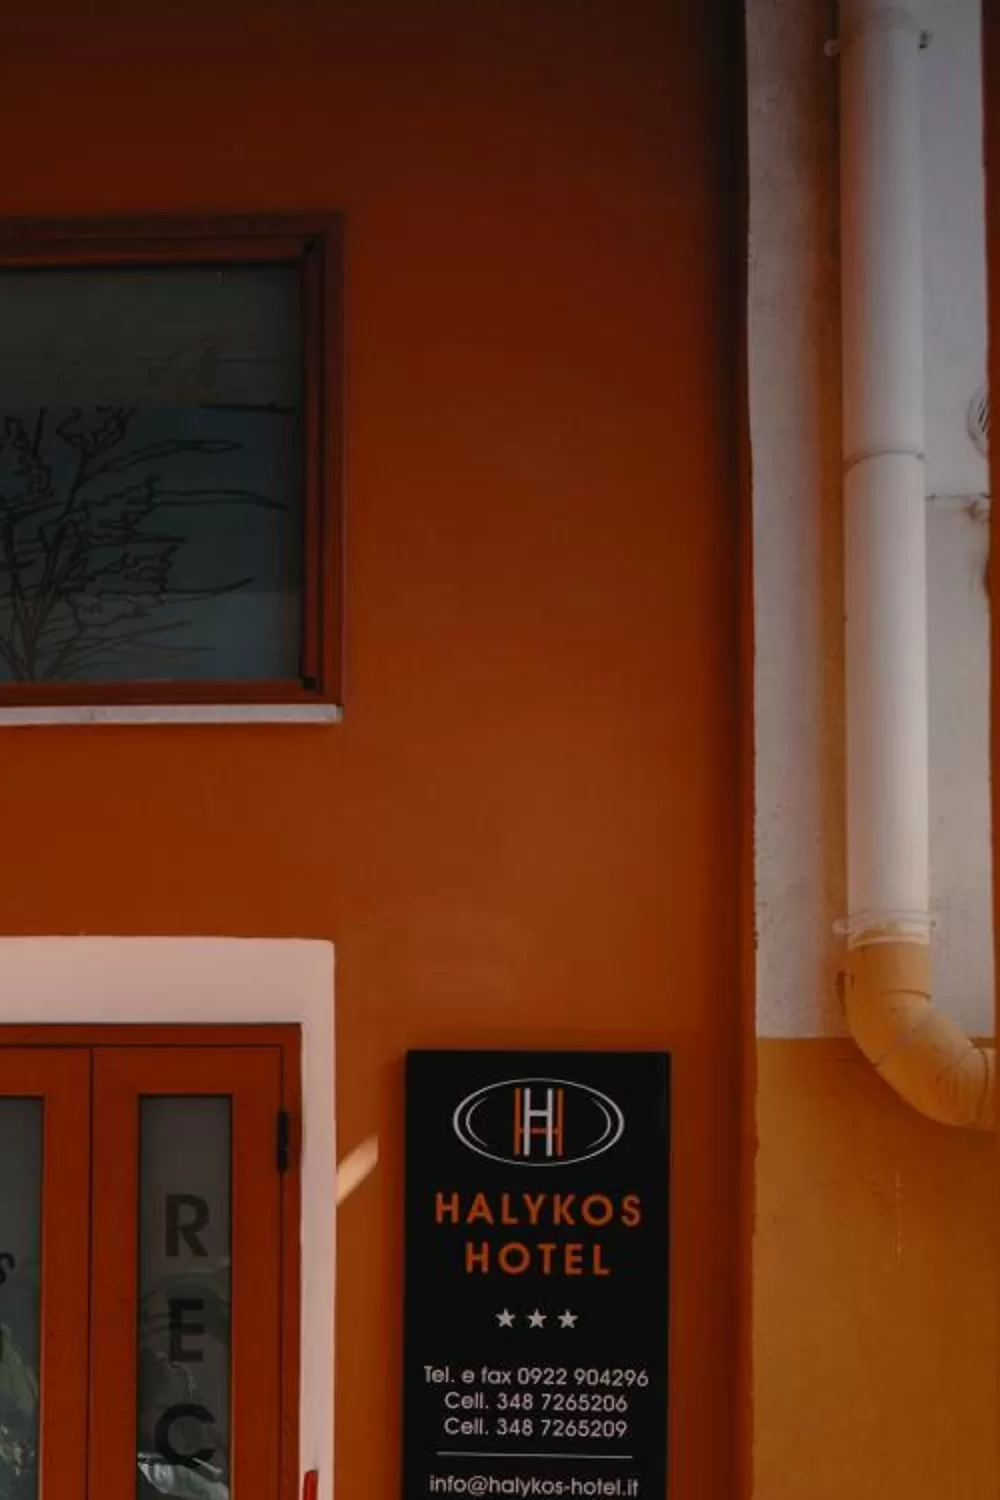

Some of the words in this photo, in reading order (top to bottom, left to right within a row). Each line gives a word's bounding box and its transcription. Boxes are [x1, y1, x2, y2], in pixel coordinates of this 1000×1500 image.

[435, 1191, 641, 1227] HALYKOS
[465, 1241, 610, 1275] HOTEL
[424, 1366, 456, 1384] Tel.
[461, 1369, 476, 1384] e
[481, 1367, 512, 1385] fax
[517, 1367, 567, 1385] 0922
[573, 1368, 649, 1387] 904296
[444, 1391, 489, 1409] Cell.
[496, 1392, 533, 1410] 348
[541, 1393, 628, 1412] 7265206
[444, 1417, 489, 1435] Cell.
[496, 1418, 533, 1436] 348
[540, 1418, 628, 1437] 7265209
[429, 1475, 639, 1498] info@halykos-hotel.it
